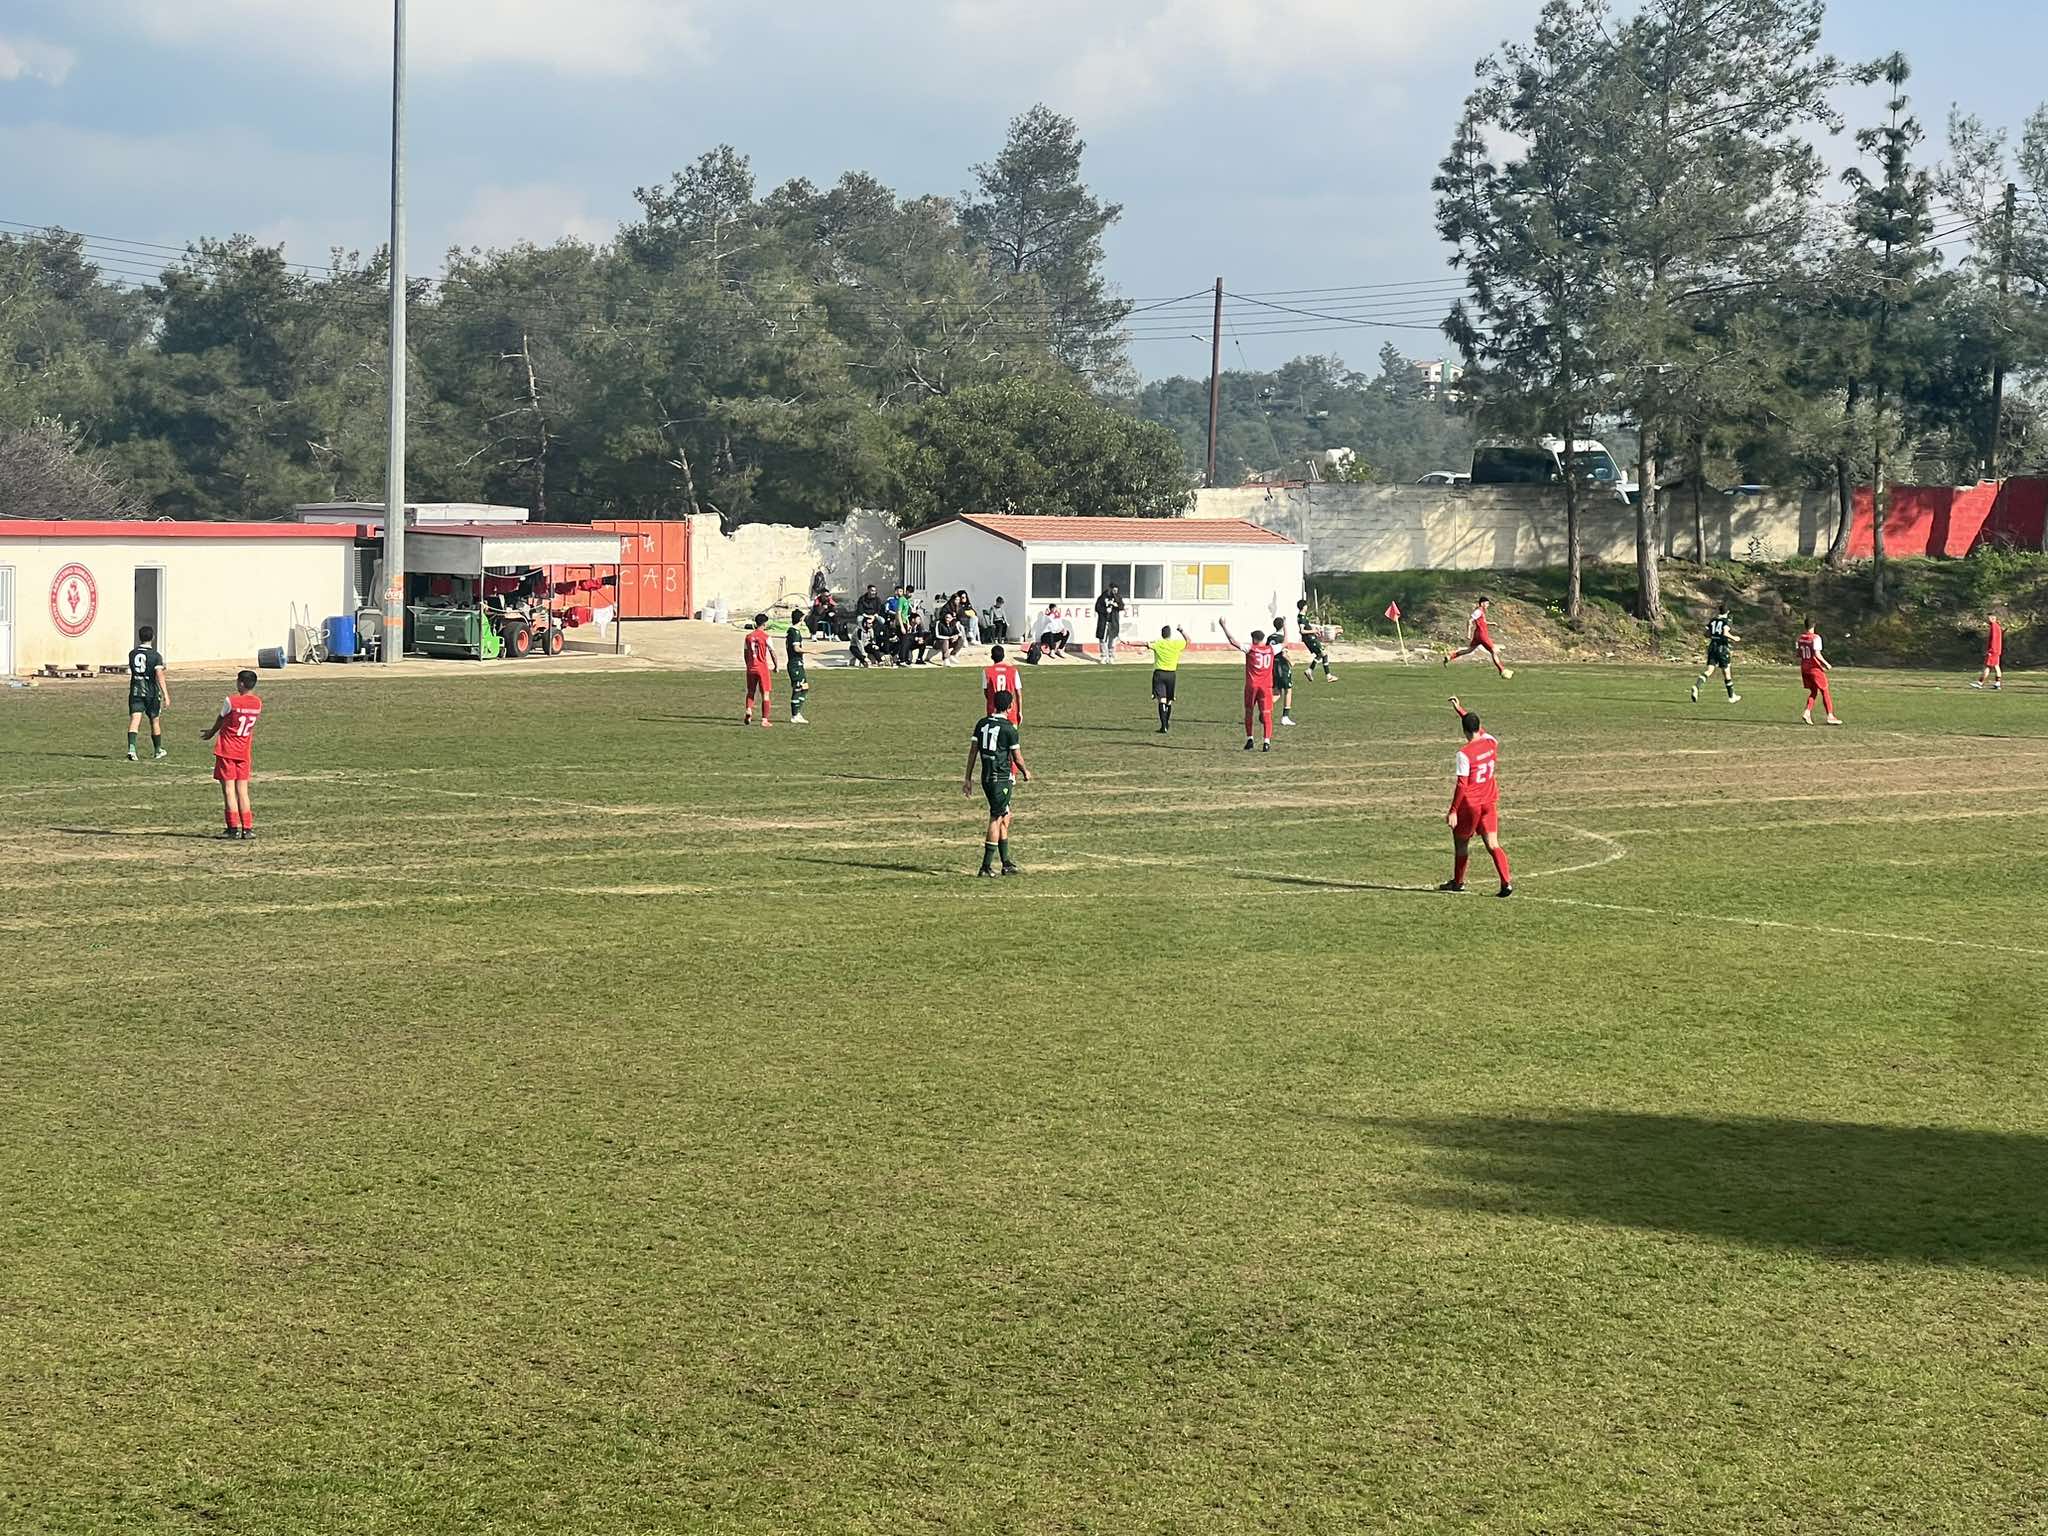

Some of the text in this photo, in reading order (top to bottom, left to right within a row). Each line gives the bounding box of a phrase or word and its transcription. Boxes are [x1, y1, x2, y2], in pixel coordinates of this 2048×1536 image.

[1711, 620, 1723, 635] 14
[134, 653, 147, 673] 9
[1253, 653, 1271, 669] 30
[237, 716, 256, 737] 12
[981, 723, 1000, 751] 11
